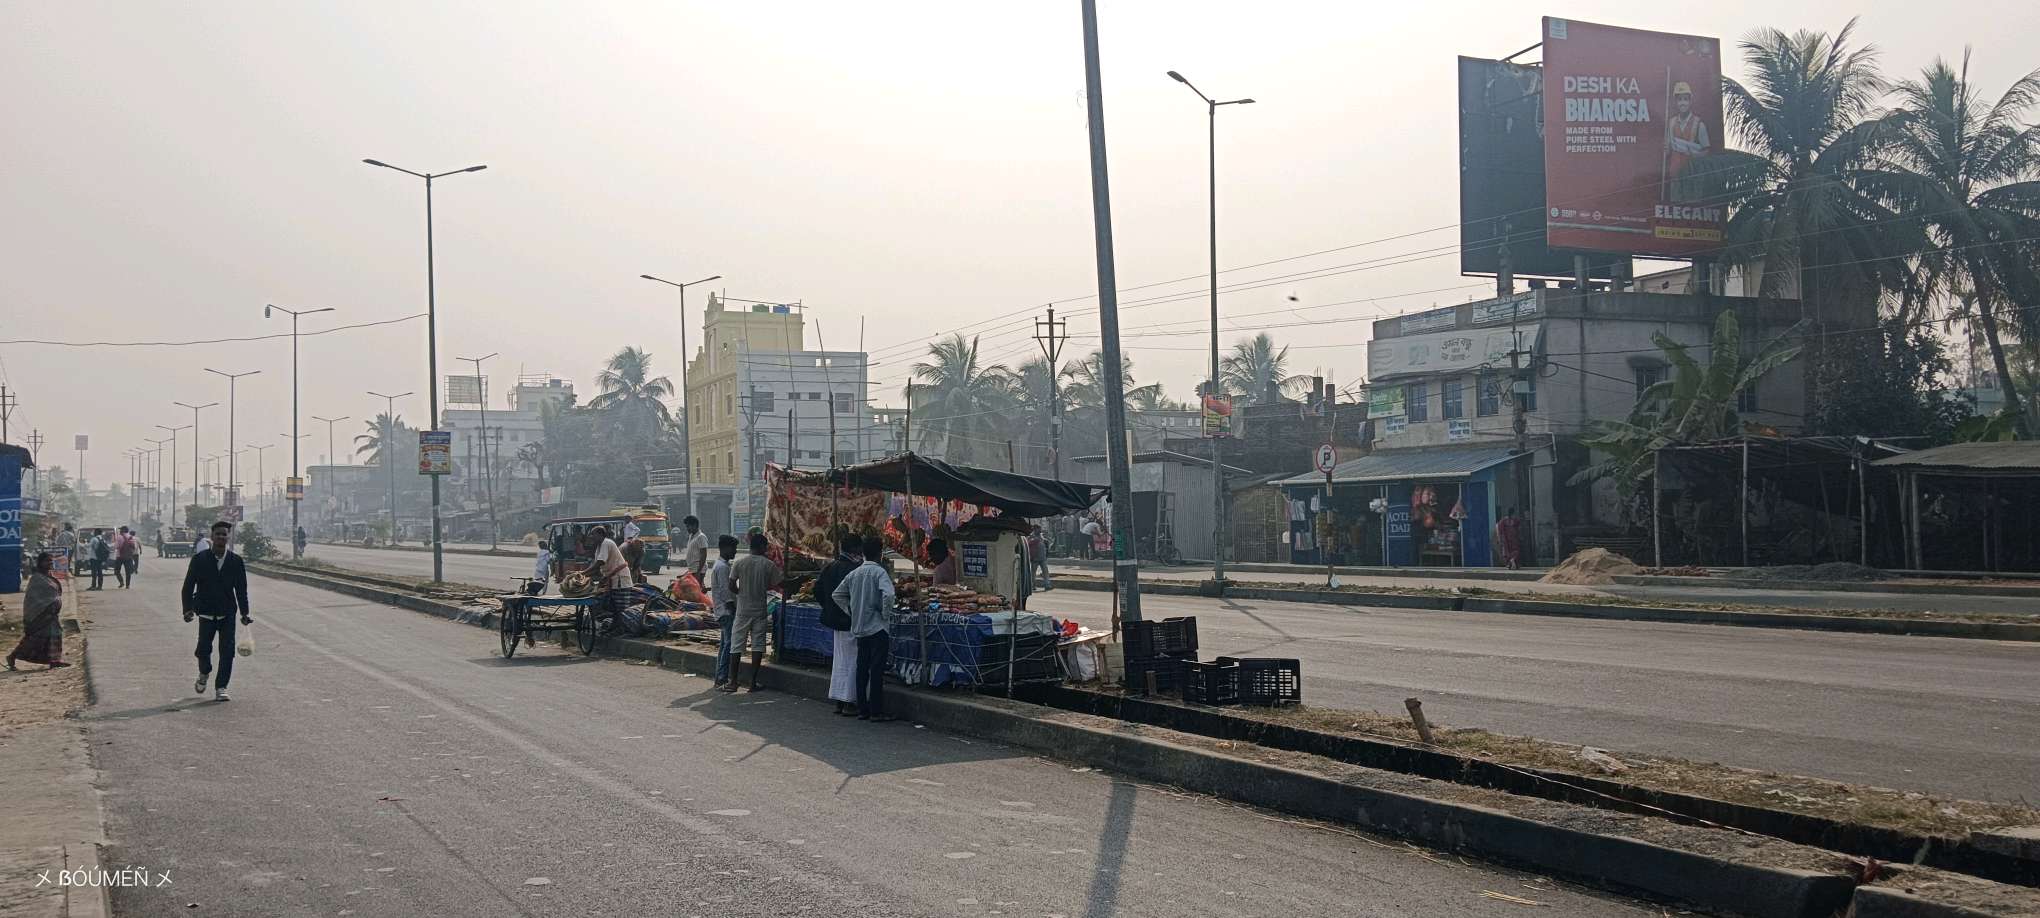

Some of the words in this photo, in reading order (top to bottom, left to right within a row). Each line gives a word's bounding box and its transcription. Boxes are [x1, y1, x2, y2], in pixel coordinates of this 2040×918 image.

[1563, 76, 1612, 93] DESH
[1616, 77, 1640, 94] KA
[1565, 98, 1650, 122] BHAROSA
[1566, 126, 1589, 134] MADE
[1590, 126, 1613, 134] FROM
[1566, 135, 1589, 143] PURE
[1590, 135, 1614, 143] STEEL
[1616, 135, 1637, 144] WITH
[1566, 144, 1616, 153] PERFECTION
[1655, 204, 1720, 223] ELEGANT
